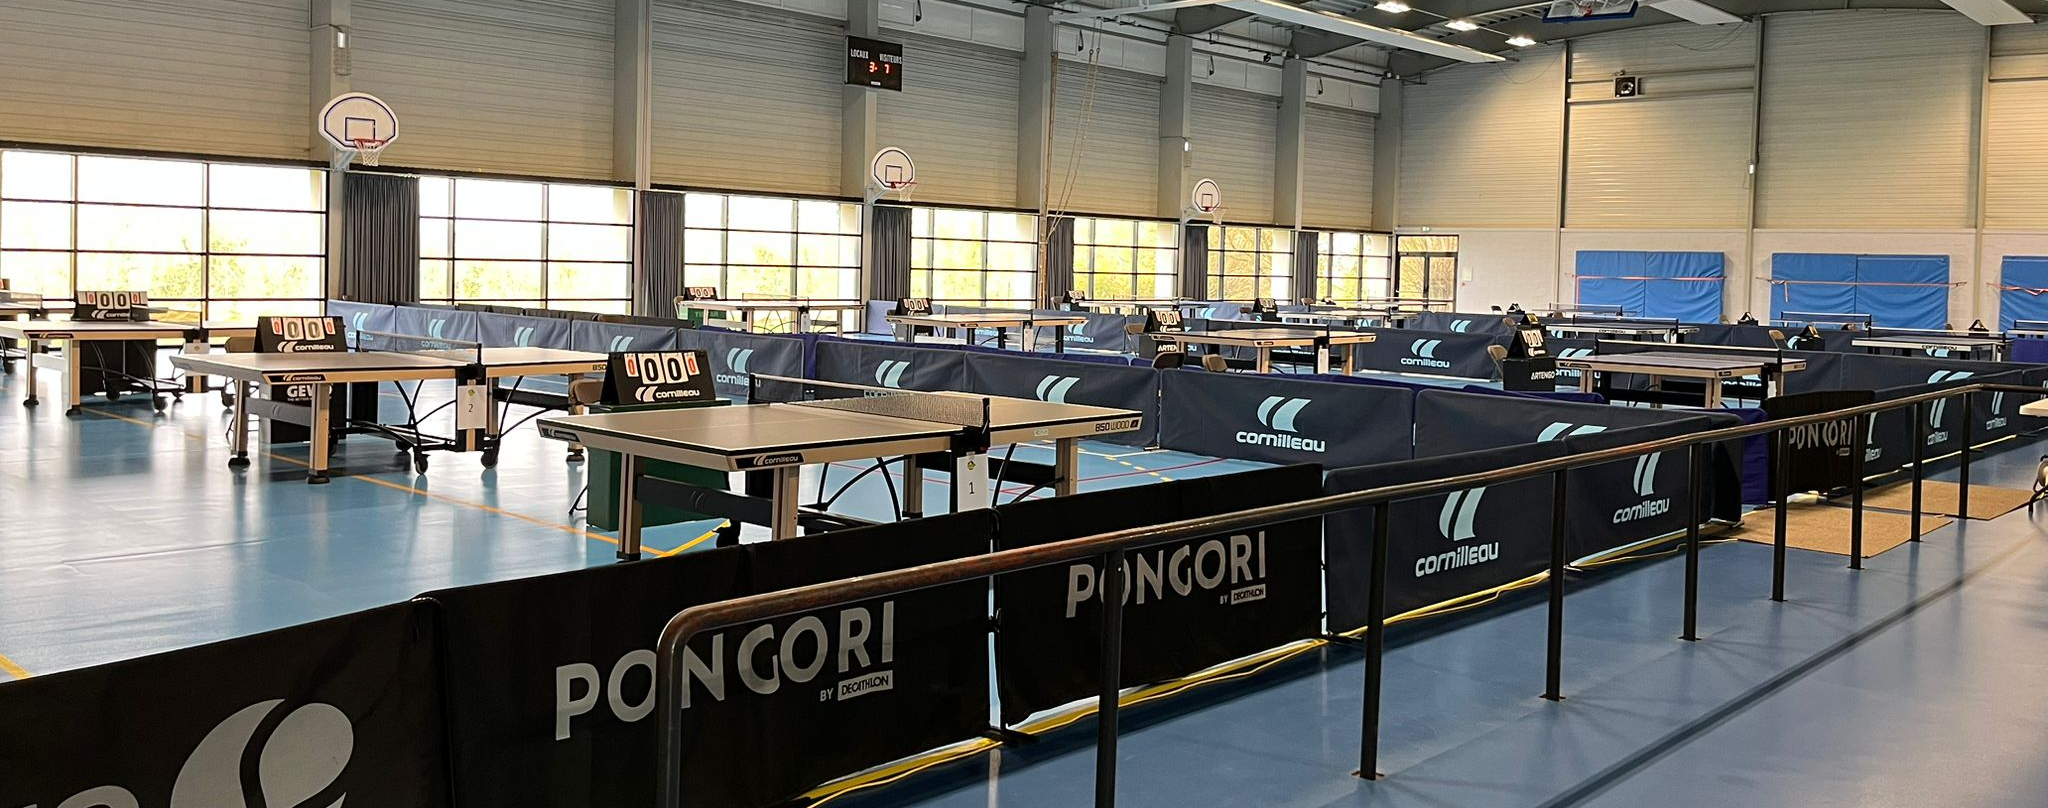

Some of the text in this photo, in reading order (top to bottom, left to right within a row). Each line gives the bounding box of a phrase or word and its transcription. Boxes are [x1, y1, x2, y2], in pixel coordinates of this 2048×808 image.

[851, 49, 902, 64] LOCAUX VISITEURS
[100, 293, 110, 307] 0
[117, 293, 127, 307] 0
[287, 321, 300, 338] 0
[307, 321, 321, 338] 0
[627, 357, 697, 382] 0 0 0 0
[1401, 357, 1450, 368] cornilleau
[716, 373, 761, 387] cornilleu
[1531, 371, 1555, 380] ARTENGO
[655, 389, 700, 399] cornilleau
[468, 404, 474, 413] 2
[1236, 431, 1325, 453] cornilleau
[764, 456, 799, 464] cornilleau
[968, 481, 975, 495] 1
[1613, 498, 1670, 524] cornilleau
[1415, 542, 1499, 577] cornilleau
[1220, 588, 1264, 604] BY DECATHLON
[555, 600, 894, 741] PONGORI
[820, 674, 890, 702] BY DECATHLON
